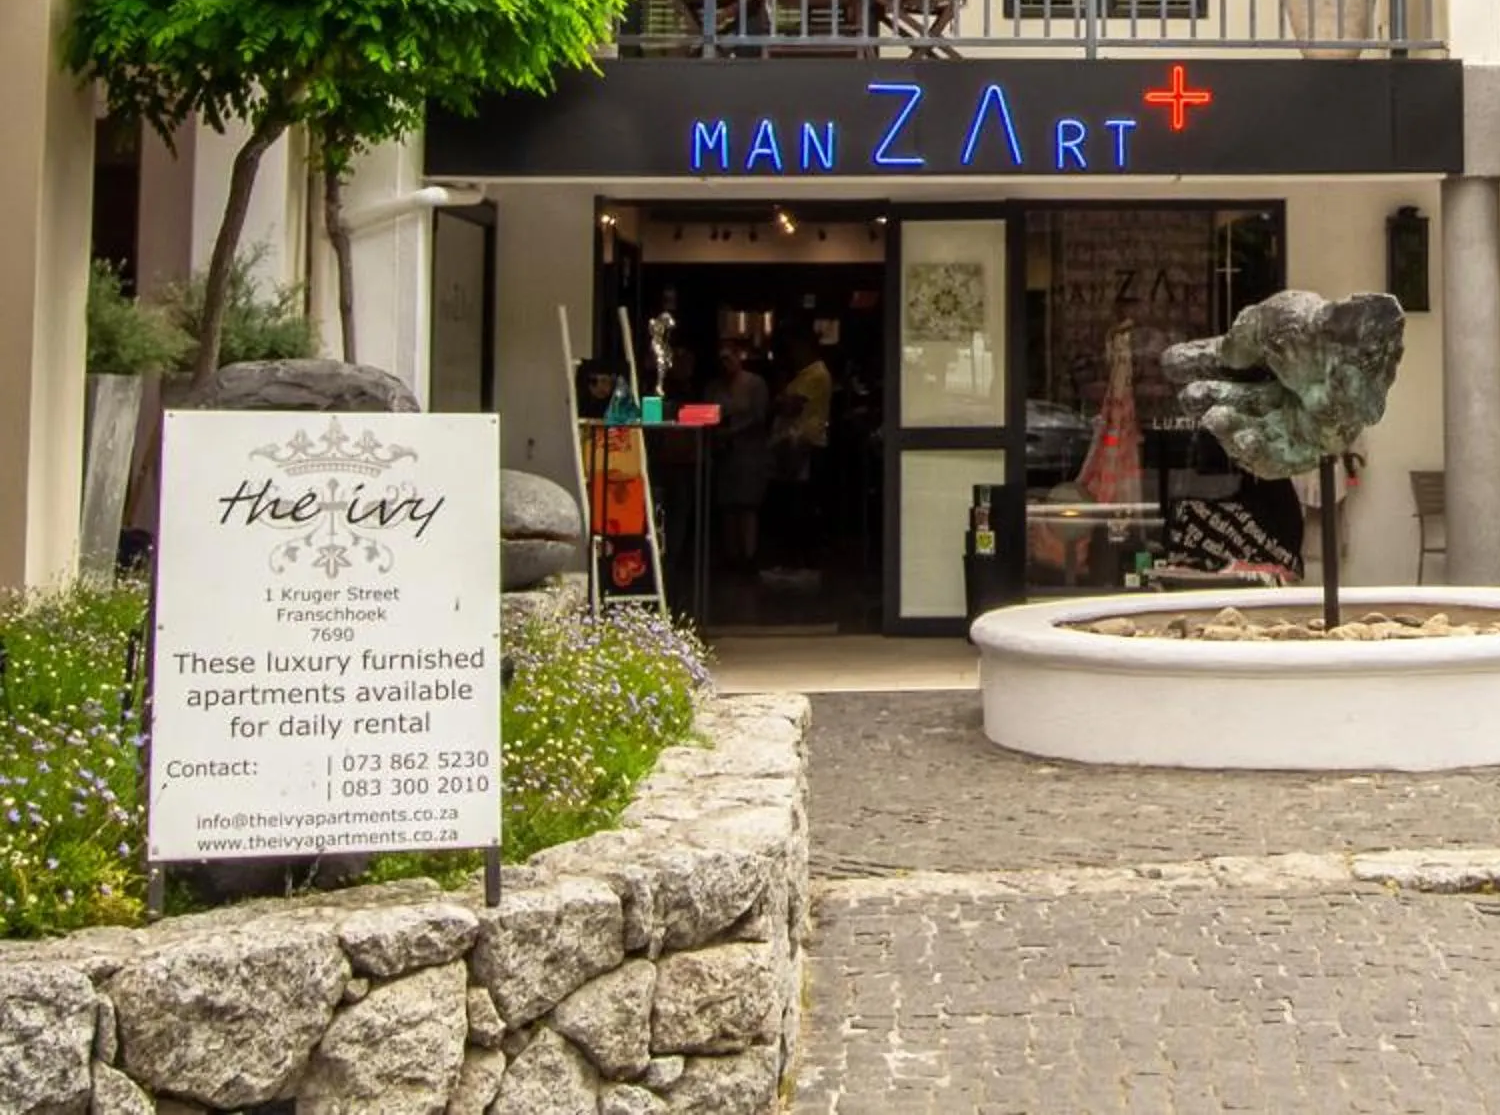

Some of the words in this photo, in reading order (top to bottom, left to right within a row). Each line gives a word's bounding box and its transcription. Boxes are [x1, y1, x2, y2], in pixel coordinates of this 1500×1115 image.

[218, 478, 322, 526] the
[346, 483, 445, 538] ivy
[265, 588, 273, 603] 1
[280, 587, 341, 605] Kruger
[346, 586, 401, 602] Street
[276, 607, 388, 623] Franschhoek
[310, 627, 355, 643] 7690
[173, 652, 256, 674] These
[266, 651, 351, 675] luxury
[361, 648, 486, 671] furnished
[186, 683, 346, 711] apartments
[355, 679, 474, 702] available
[230, 716, 269, 738] for
[279, 714, 342, 740] daily
[353, 711, 432, 735] rental
[166, 759, 259, 779] Contact:
[342, 753, 382, 773] 073
[390, 751, 430, 771] 862
[438, 749, 490, 770] 5230
[341, 779, 382, 798] 083
[391, 777, 430, 796] 300
[437, 775, 490, 794] 2010
[196, 806, 460, 831] info@theivyapartments.co.za
[196, 830, 460, 852] www.theivyapartments.co.za
